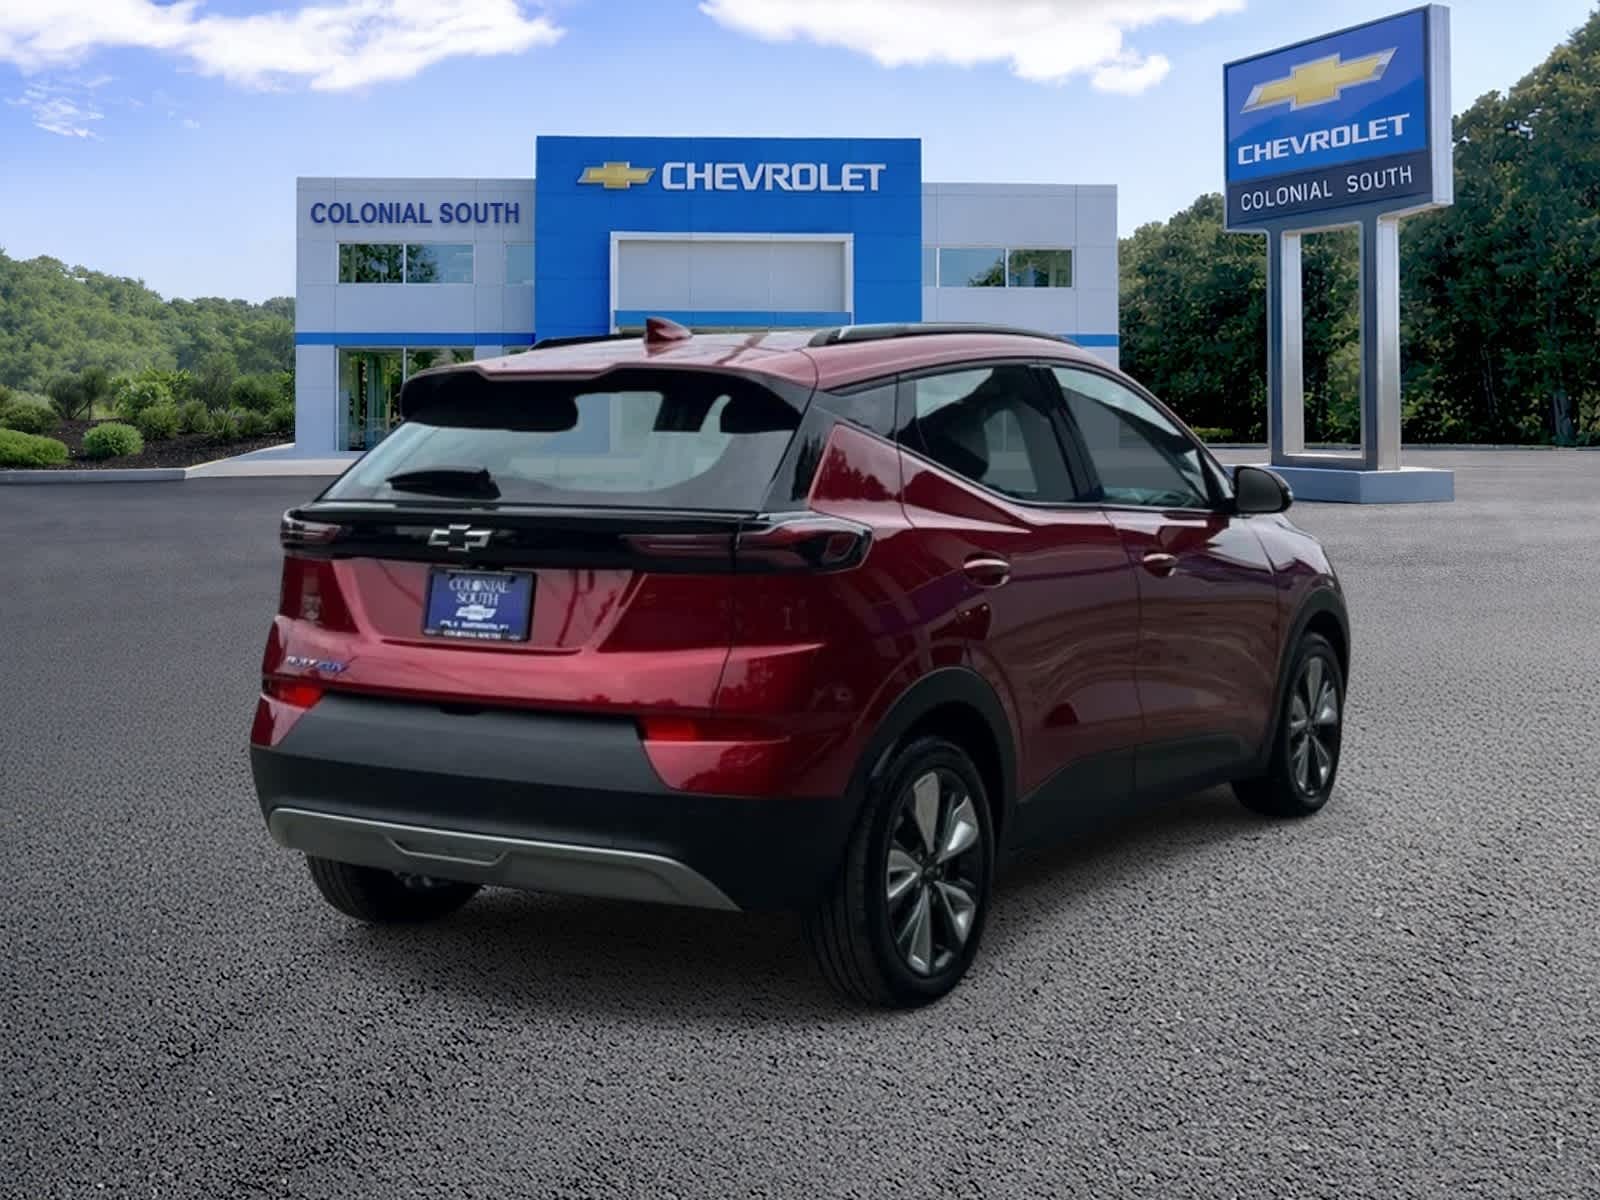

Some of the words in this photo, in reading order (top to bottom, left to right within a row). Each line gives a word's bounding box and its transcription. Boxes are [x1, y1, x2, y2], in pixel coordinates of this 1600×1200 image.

[1237, 113, 1410, 165] CHEVROLET
[662, 162, 886, 192] CHEVROLET
[1241, 180, 1333, 211] COLONIAL
[1346, 165, 1412, 193] SOUTH
[310, 202, 433, 225] COLONIAL
[439, 202, 520, 224] SOUTH
[449, 578, 508, 594] COLONIAL
[456, 591, 499, 606] SOUTH
